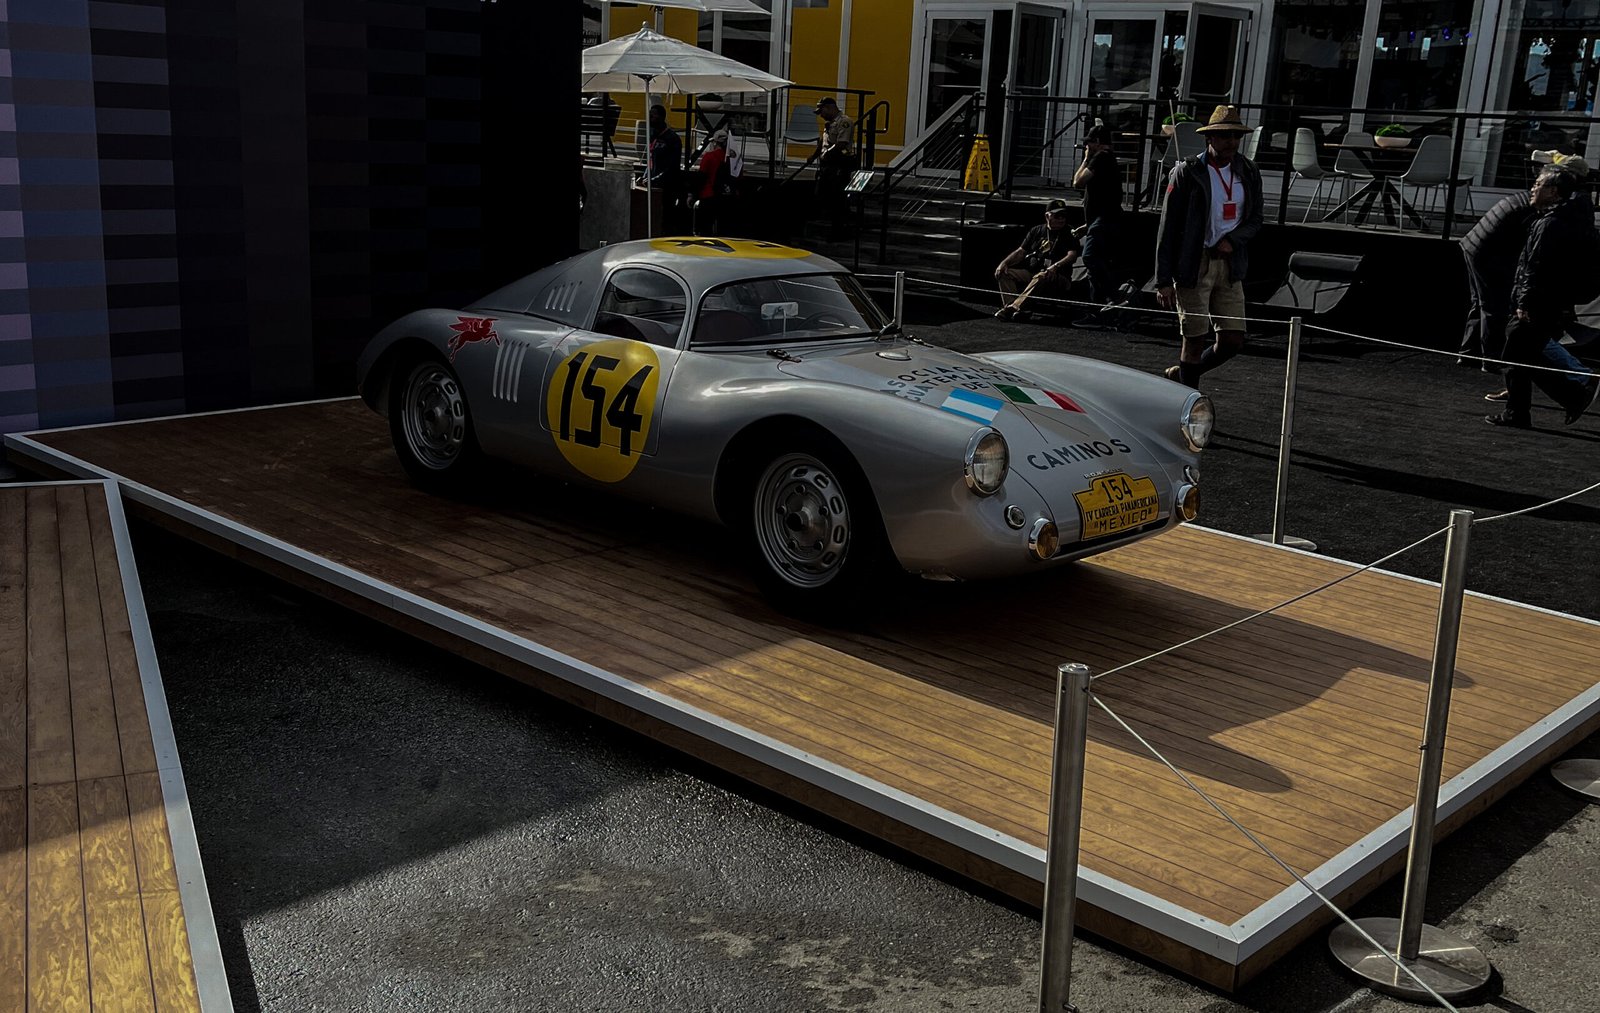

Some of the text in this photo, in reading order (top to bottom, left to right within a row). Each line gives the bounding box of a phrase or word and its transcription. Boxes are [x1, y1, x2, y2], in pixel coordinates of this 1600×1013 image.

[961, 381, 990, 390] DE
[561, 351, 654, 457] 154
[1027, 439, 1132, 470] CAMINOS
[1101, 476, 1134, 503] 154
[1085, 495, 1158, 522] IV CARRERA PANAMERICANA
